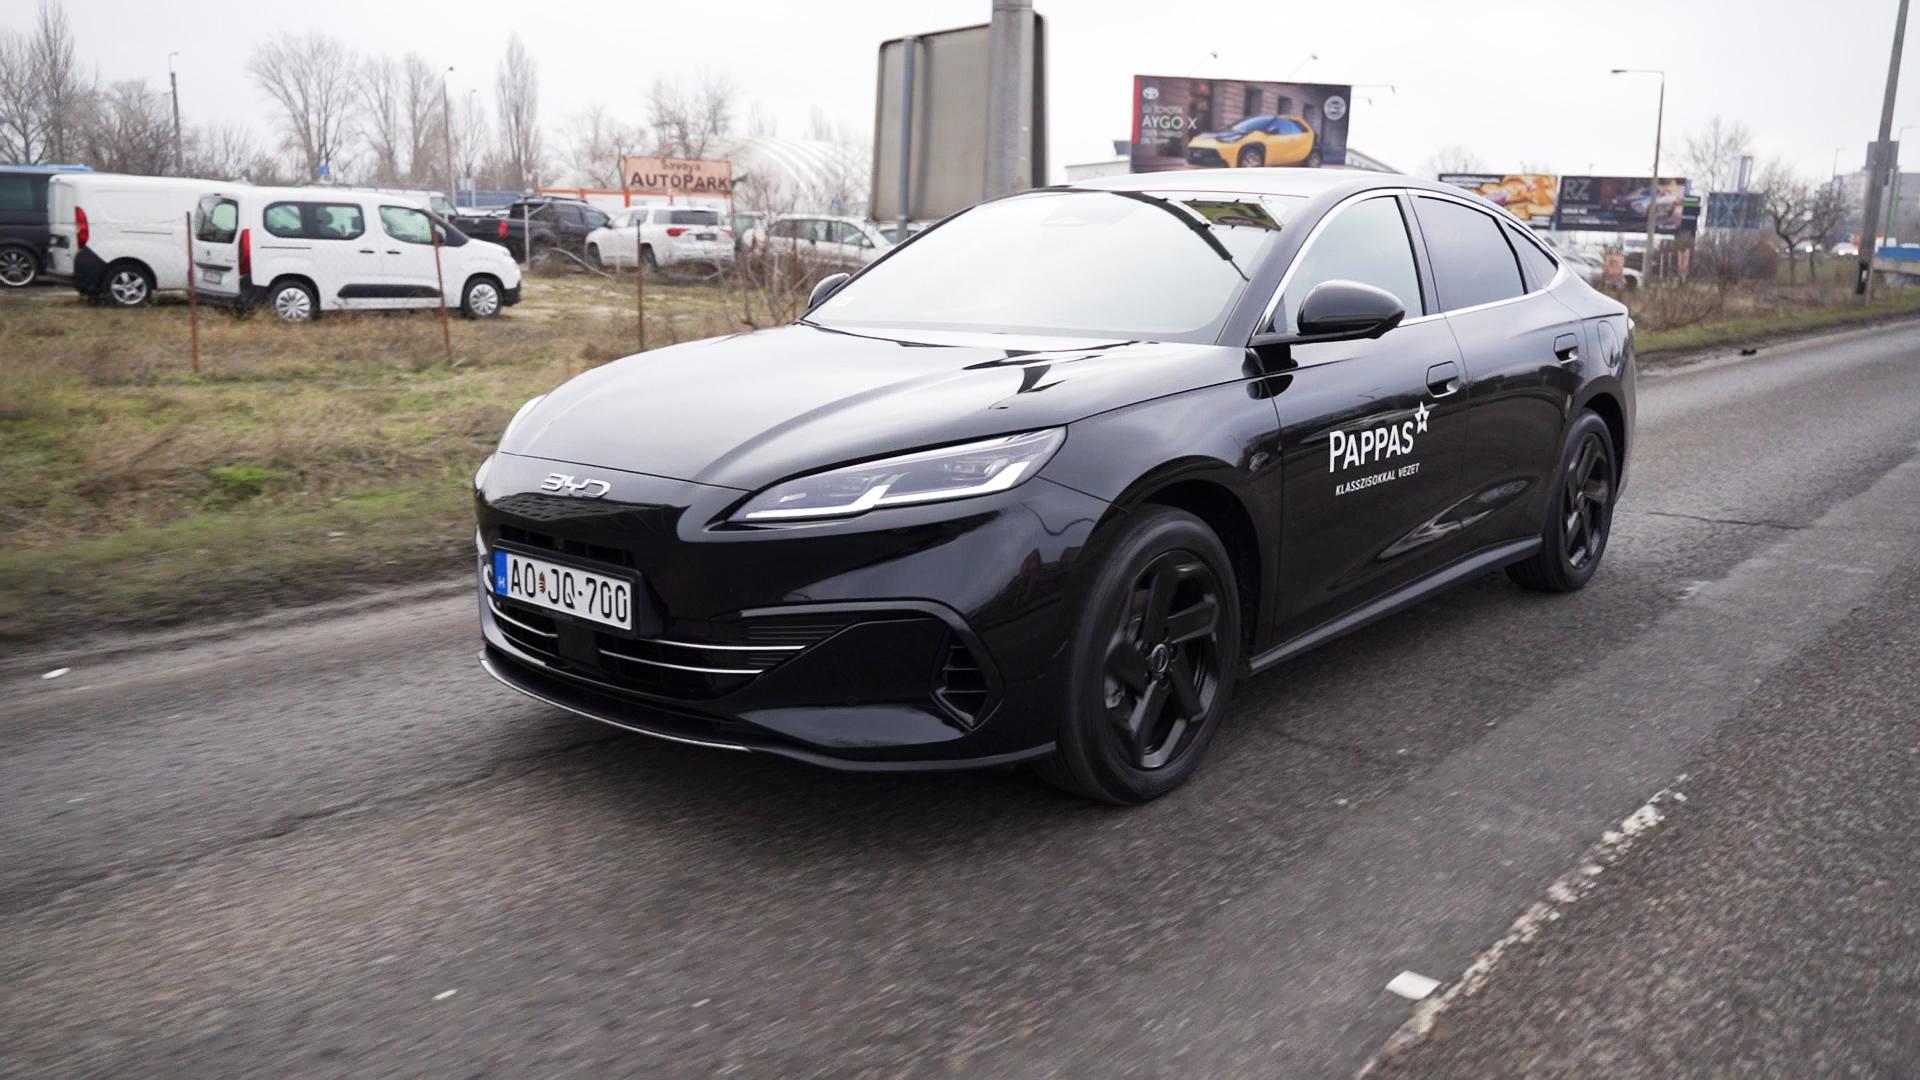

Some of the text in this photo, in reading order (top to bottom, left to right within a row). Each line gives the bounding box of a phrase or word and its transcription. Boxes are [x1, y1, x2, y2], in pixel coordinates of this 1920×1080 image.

[1142, 114, 1198, 130] AYGO X
[630, 172, 728, 190] AUTOPARK
[1563, 178, 1590, 198] RZ
[540, 472, 612, 498] BYD
[1335, 463, 1421, 496] KLASSZISOKKAL VEZET
